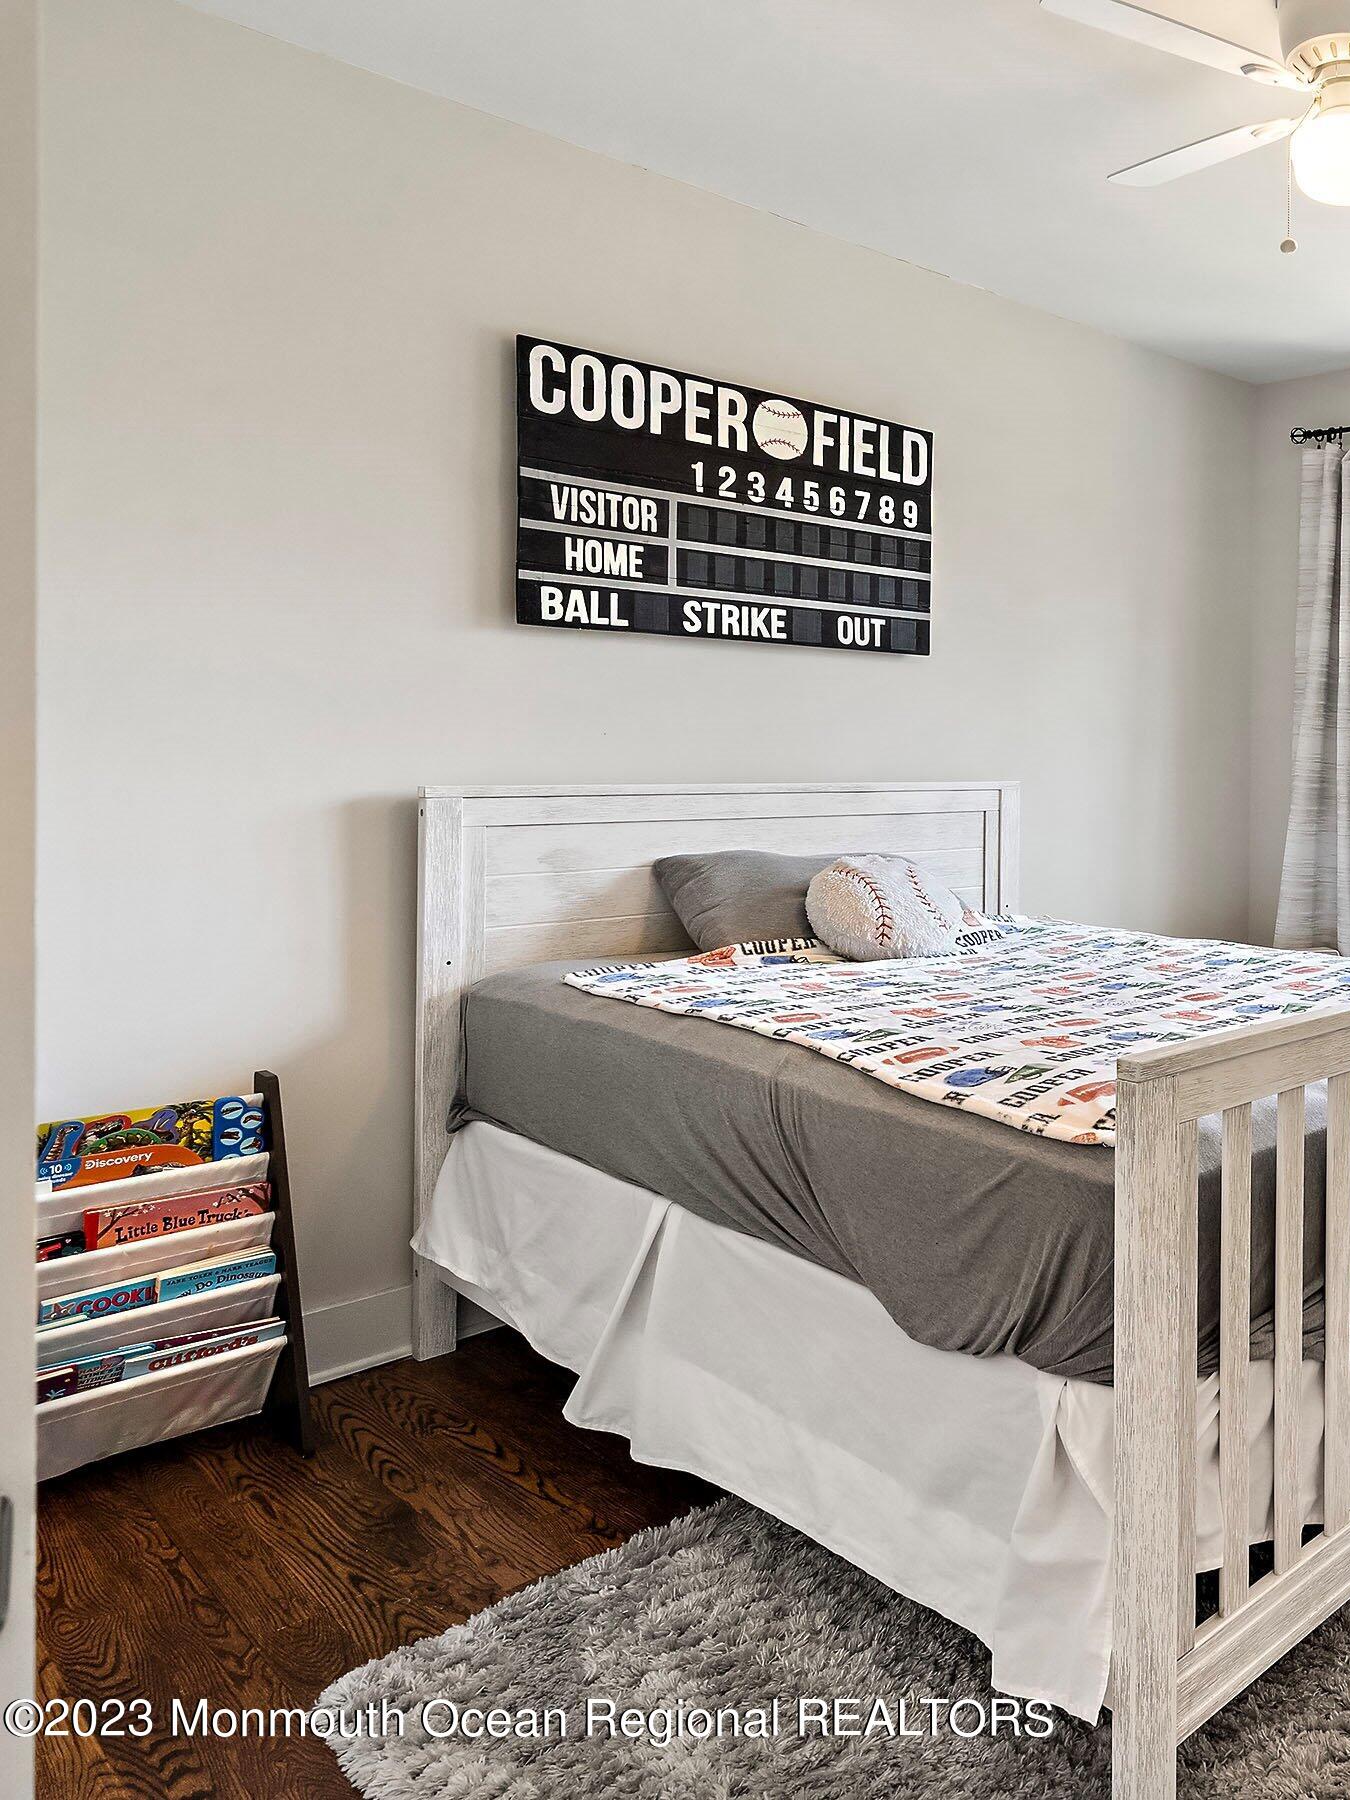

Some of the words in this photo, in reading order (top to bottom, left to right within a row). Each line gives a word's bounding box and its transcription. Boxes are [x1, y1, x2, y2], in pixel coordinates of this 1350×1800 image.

[529, 344, 749, 452] COOPER
[813, 410, 928, 486] FIELD
[550, 484, 658, 533] VISITOR
[691, 461, 705, 493] 1
[718, 466, 738, 498] 2
[747, 471, 766, 503] 3
[775, 476, 794, 508] 4
[803, 481, 820, 512] 5
[829, 486, 846, 517] 6
[855, 490, 871, 520] 7
[878, 495, 896, 524] 8
[902, 499, 918, 528] 9
[565, 536, 645, 578] HOME
[540, 586, 629, 627] BALL
[682, 600, 788, 640] STRIKE
[837, 615, 886, 648] OUT
[955, 929, 1005, 949] COOPER
[997, 1068, 1097, 1108] COOPER
[49, 1164, 63, 1175] 10
[84, 1152, 153, 1170] Discovery
[114, 1222, 159, 1245] Little
[162, 1215, 196, 1232] Blue
[195, 1281, 214, 1292] Do
